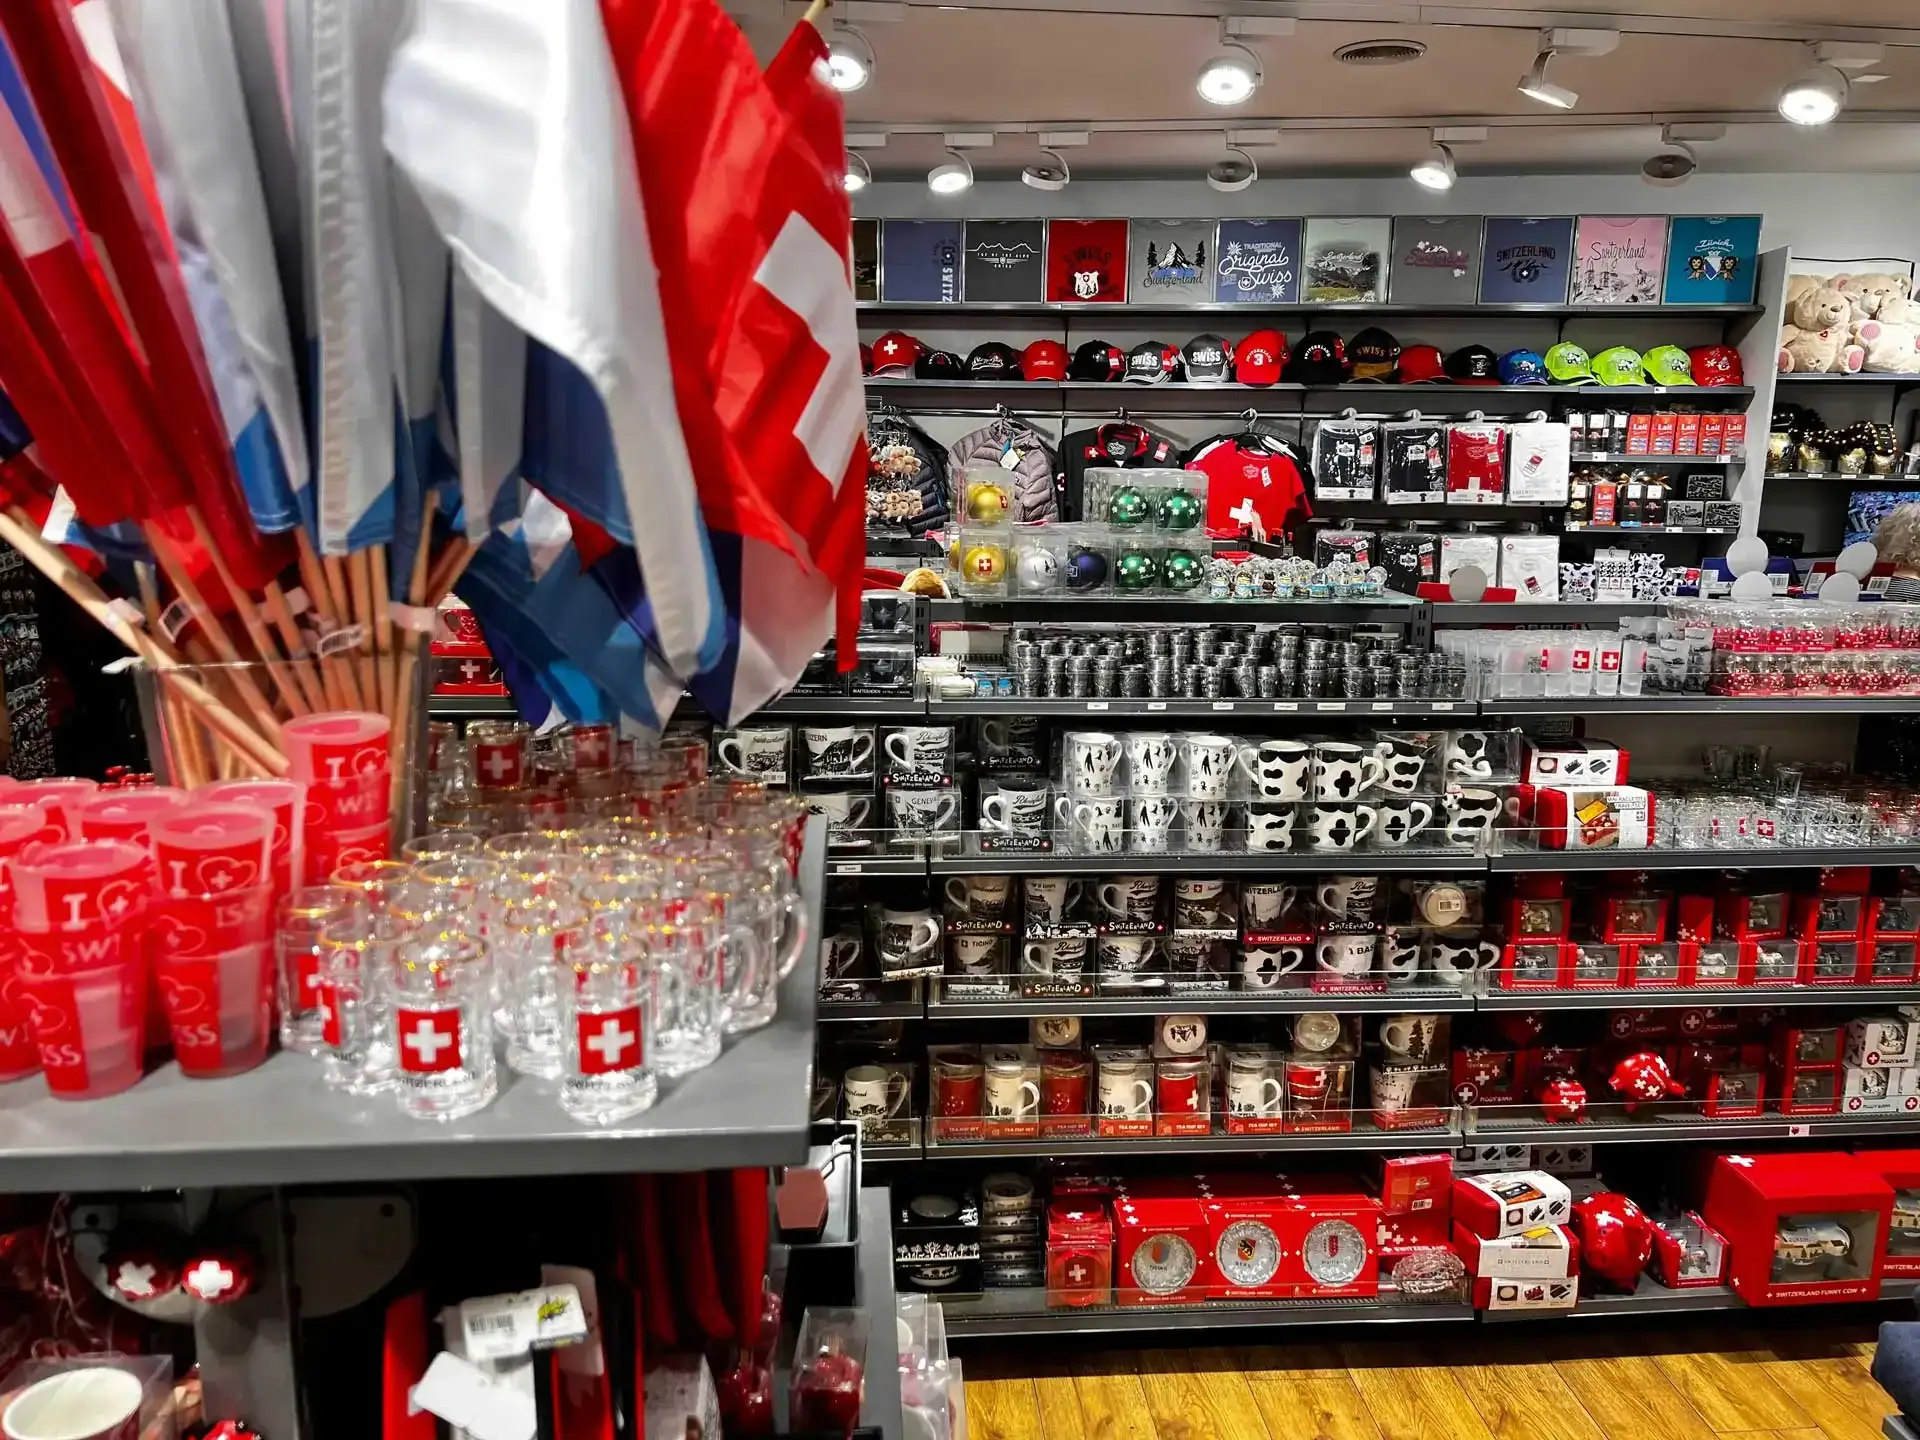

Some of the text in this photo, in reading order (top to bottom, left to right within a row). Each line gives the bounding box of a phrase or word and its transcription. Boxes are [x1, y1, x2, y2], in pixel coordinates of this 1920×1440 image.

[1243, 242, 1283, 250] TRADITIONAL
[1065, 246, 1112, 263] SWISS
[1497, 245, 1557, 262] SWITZERLAND
[1218, 248, 1290, 275] Original
[1238, 268, 1293, 290] Swiss
[1356, 346, 1385, 357] SWISS
[1253, 353, 1263, 366] 3
[1633, 423, 1648, 431] Lait
[1657, 423, 1673, 431] Lait
[1681, 423, 1696, 431] Lait
[1705, 423, 1721, 431] Lait
[1727, 423, 1742, 431] Lait
[989, 756, 1034, 765] SWITZERLAND
[325, 757, 346, 789] I
[893, 773, 941, 783] SWITZERLAND
[992, 838, 1040, 848] SWITZERLAND
[169, 860, 188, 898] I
[62, 892, 88, 931] I
[956, 920, 1003, 931] SWITZERLAND
[1108, 921, 1155, 931] SWITZERLAND
[1328, 921, 1375, 931] SWITZERLAND
[972, 940, 993, 948] TICINO
[1034, 984, 1082, 993] SWITZERLAND
[1775, 1290, 1820, 1298] SWITZERLAND
